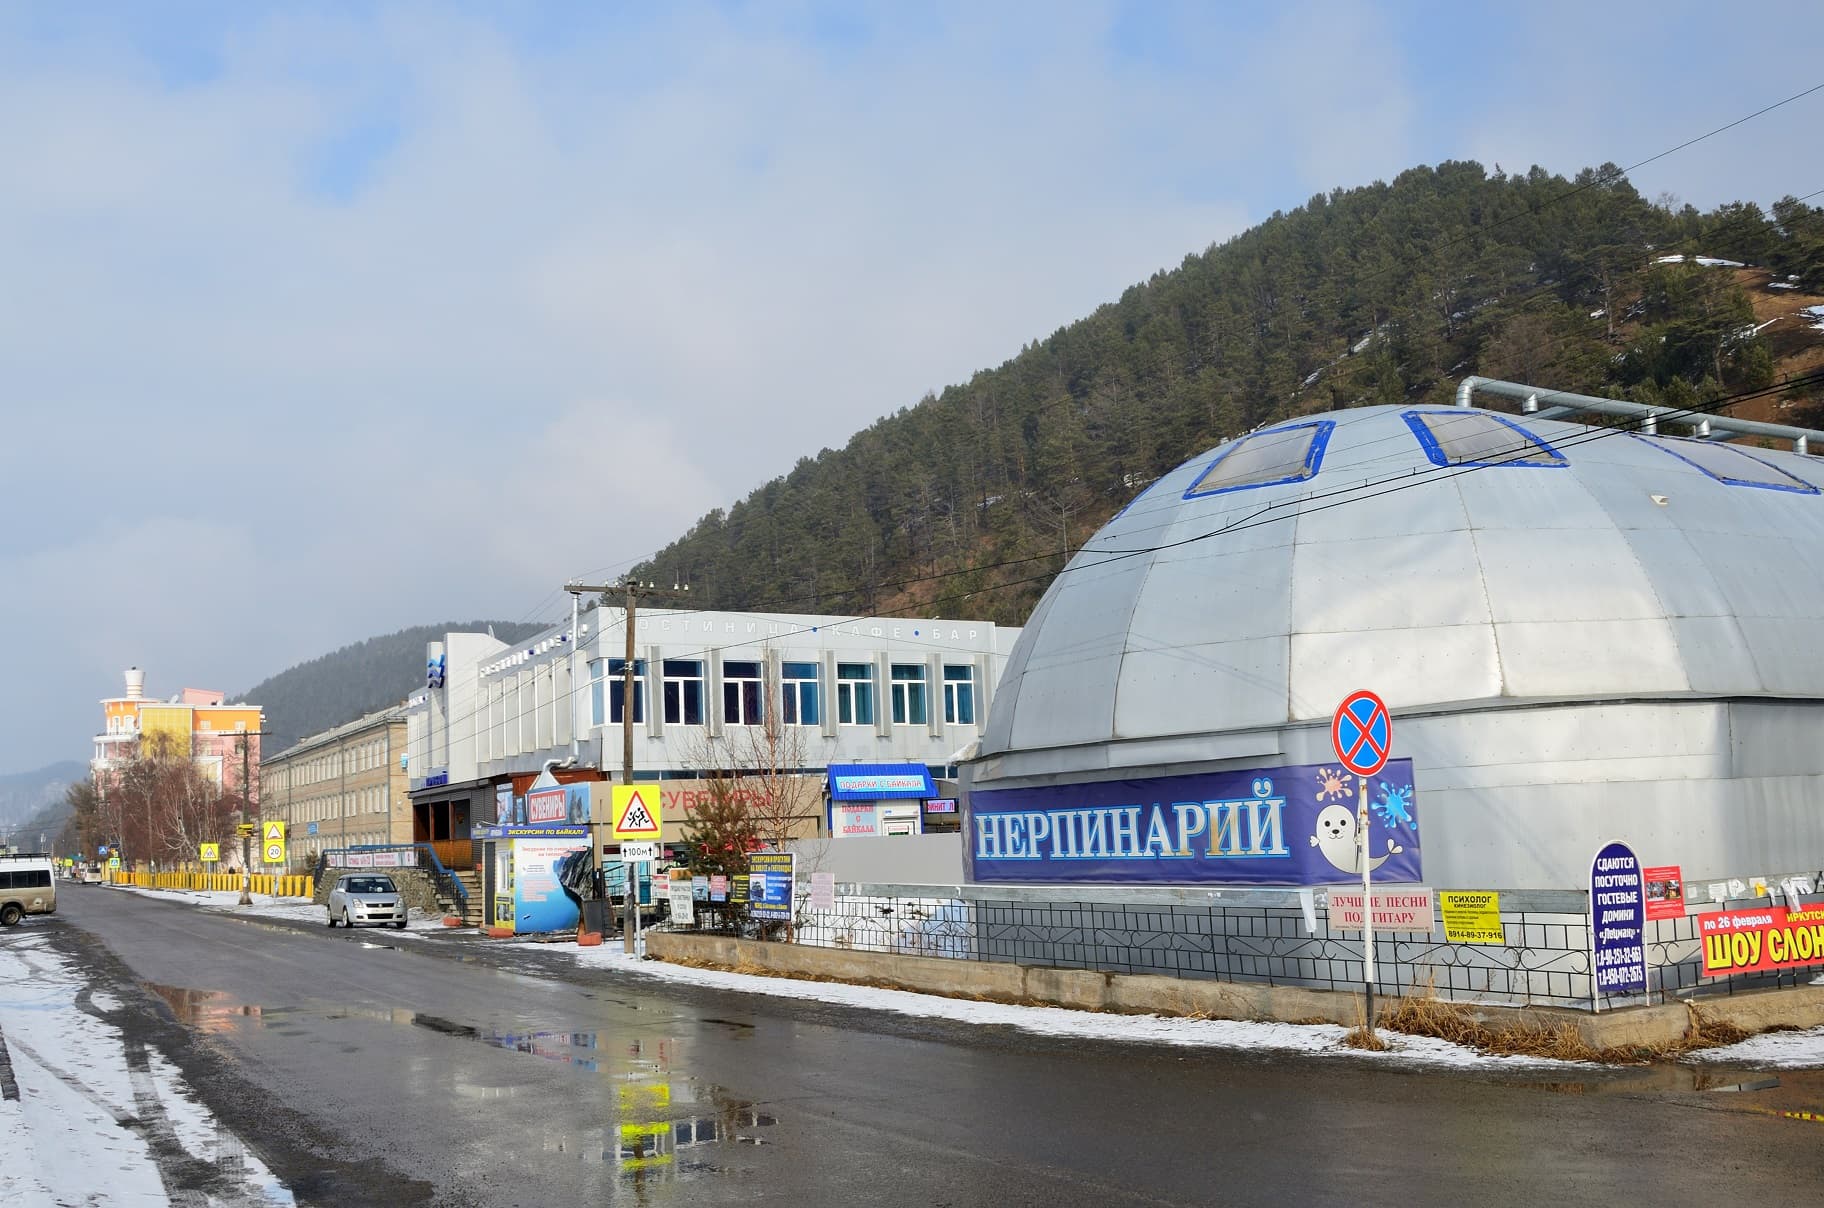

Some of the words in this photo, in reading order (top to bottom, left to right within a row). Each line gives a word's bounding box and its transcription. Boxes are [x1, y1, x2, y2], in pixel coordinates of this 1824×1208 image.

[639, 618, 799, 635] ОСТИНИЦА
[831, 625, 902, 638] КАФЕ
[932, 628, 978, 640] БАР
[840, 781, 877, 790] ПОДАРКИ
[887, 780, 922, 788] БАЙКАЛА
[531, 793, 565, 820] СУВЕНИРЫ
[841, 804, 874, 813] ПОДАРКИ
[974, 777, 1290, 861] НЕРПИНАРИЙ
[842, 824, 875, 834] БАЙКАЛА
[1597, 857, 1634, 872] СДАЮТСЯ
[1595, 874, 1638, 888] ПОСУТОЧНО
[1386, 896, 1428, 908] ПЕСНИ
[1448, 895, 1492, 903] ПСИХОЛОГ
[1597, 891, 1638, 905] ГОСТЕВЫЕ
[1344, 911, 1364, 923] ПО
[1372, 912, 1416, 924] ГИТАРУ
[1602, 909, 1634, 925] ДОМИКИ
[1704, 920, 1716, 930] по
[1718, 917, 1731, 929] 26
[1732, 914, 1773, 929] февраля
[1705, 930, 1763, 970] ШОУ
[1767, 924, 1824, 963] СЛОН
